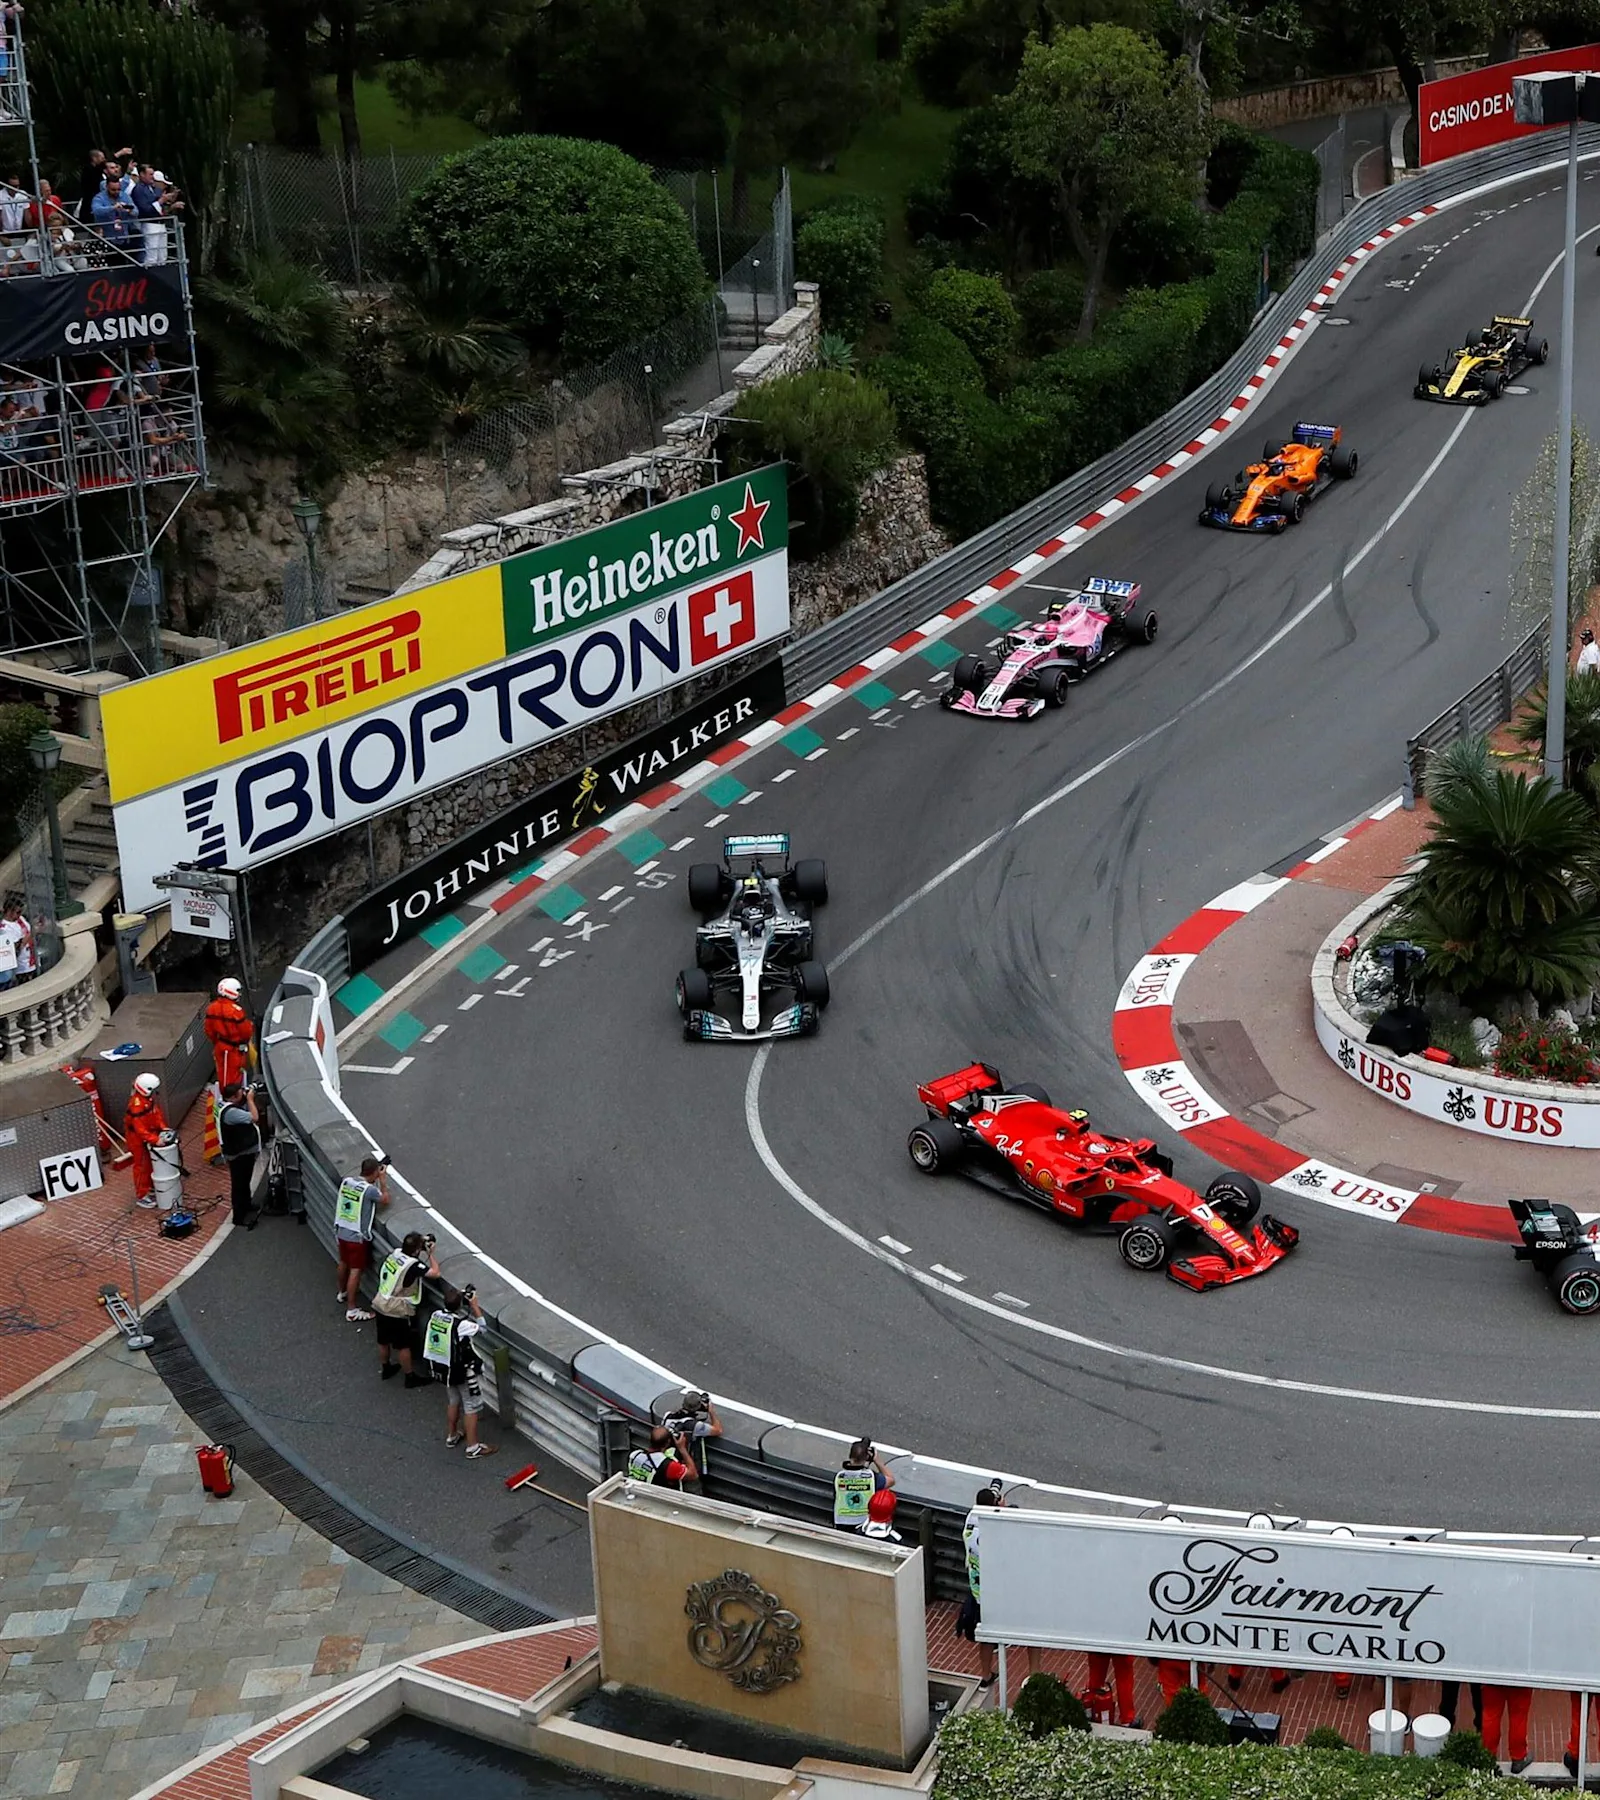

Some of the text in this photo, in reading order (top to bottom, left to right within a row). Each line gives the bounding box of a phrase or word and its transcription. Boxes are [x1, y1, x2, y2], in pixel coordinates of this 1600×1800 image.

[1429, 94, 1504, 132] CASINO DE
[84, 278, 149, 318] Sun
[64, 312, 170, 345] CASINO
[530, 520, 721, 635] Heineken
[1092, 578, 1131, 595] BWT
[213, 610, 421, 744] PIRELLI
[236, 601, 680, 855] BIOPTRON
[384, 696, 757, 945] JOHNNIE WALKER
[1132, 972, 1169, 1004] UBS
[1359, 1052, 1412, 1101] UBS
[1158, 1084, 1211, 1123] UBS
[1483, 1096, 1564, 1137] UBS
[44, 1155, 92, 1198] FCY
[1331, 1178, 1406, 1213] UBS
[1199, 1207, 1209, 1218] 7
[1535, 1240, 1567, 1249] EPSON
[1149, 1539, 1444, 1632] Fairmont
[1145, 1617, 1446, 1664] MONTE CARLO
